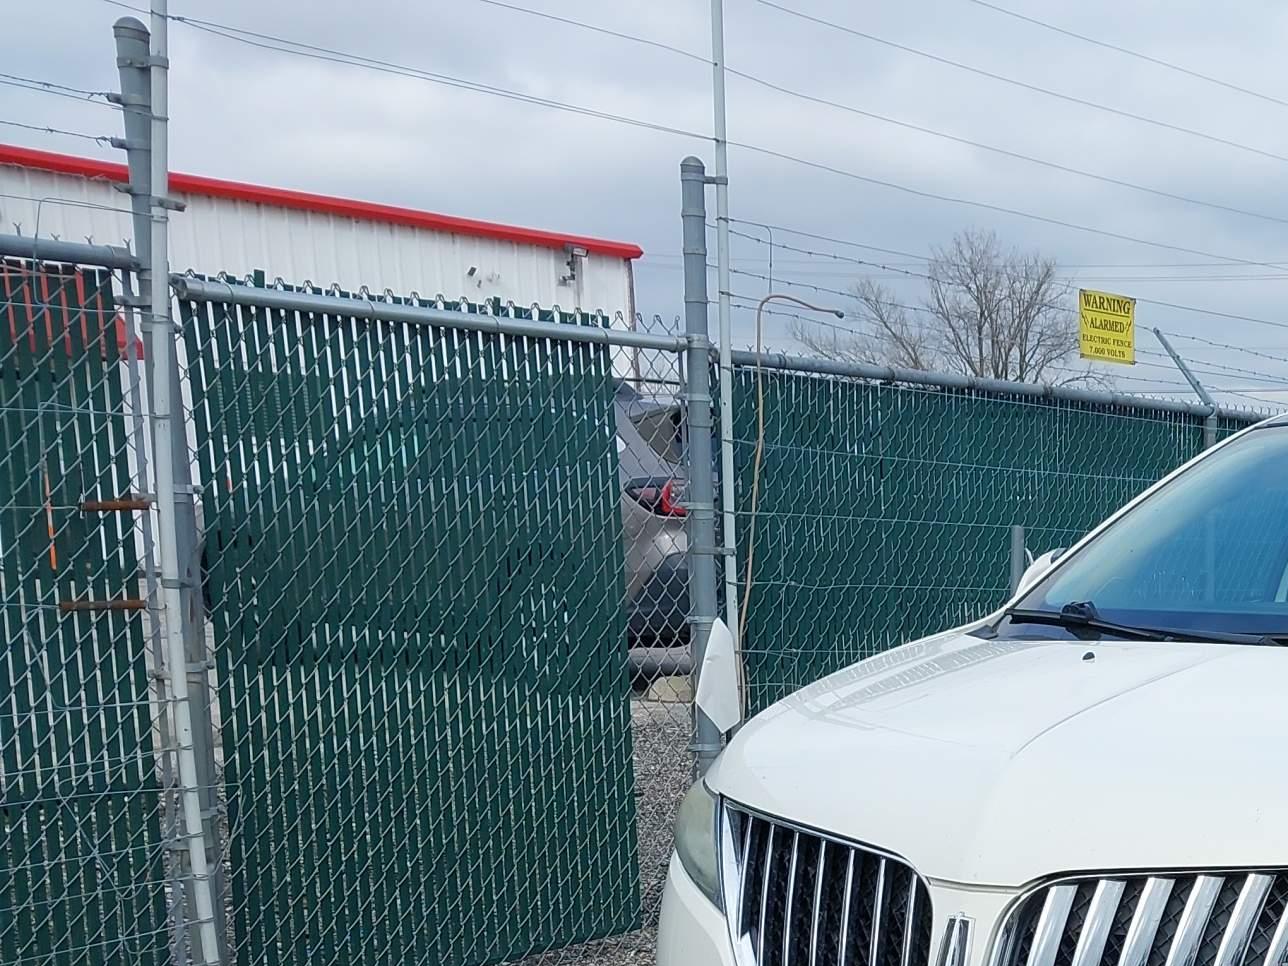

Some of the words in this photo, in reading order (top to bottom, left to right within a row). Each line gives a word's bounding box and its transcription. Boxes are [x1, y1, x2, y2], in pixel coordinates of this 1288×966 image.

[1083, 293, 1131, 314] WARNING
[1089, 316, 1125, 334] ALARMED
[1082, 333, 1112, 346] ELECTRIC
[1112, 338, 1132, 349] FENCE
[1106, 348, 1126, 359] VOLTS
